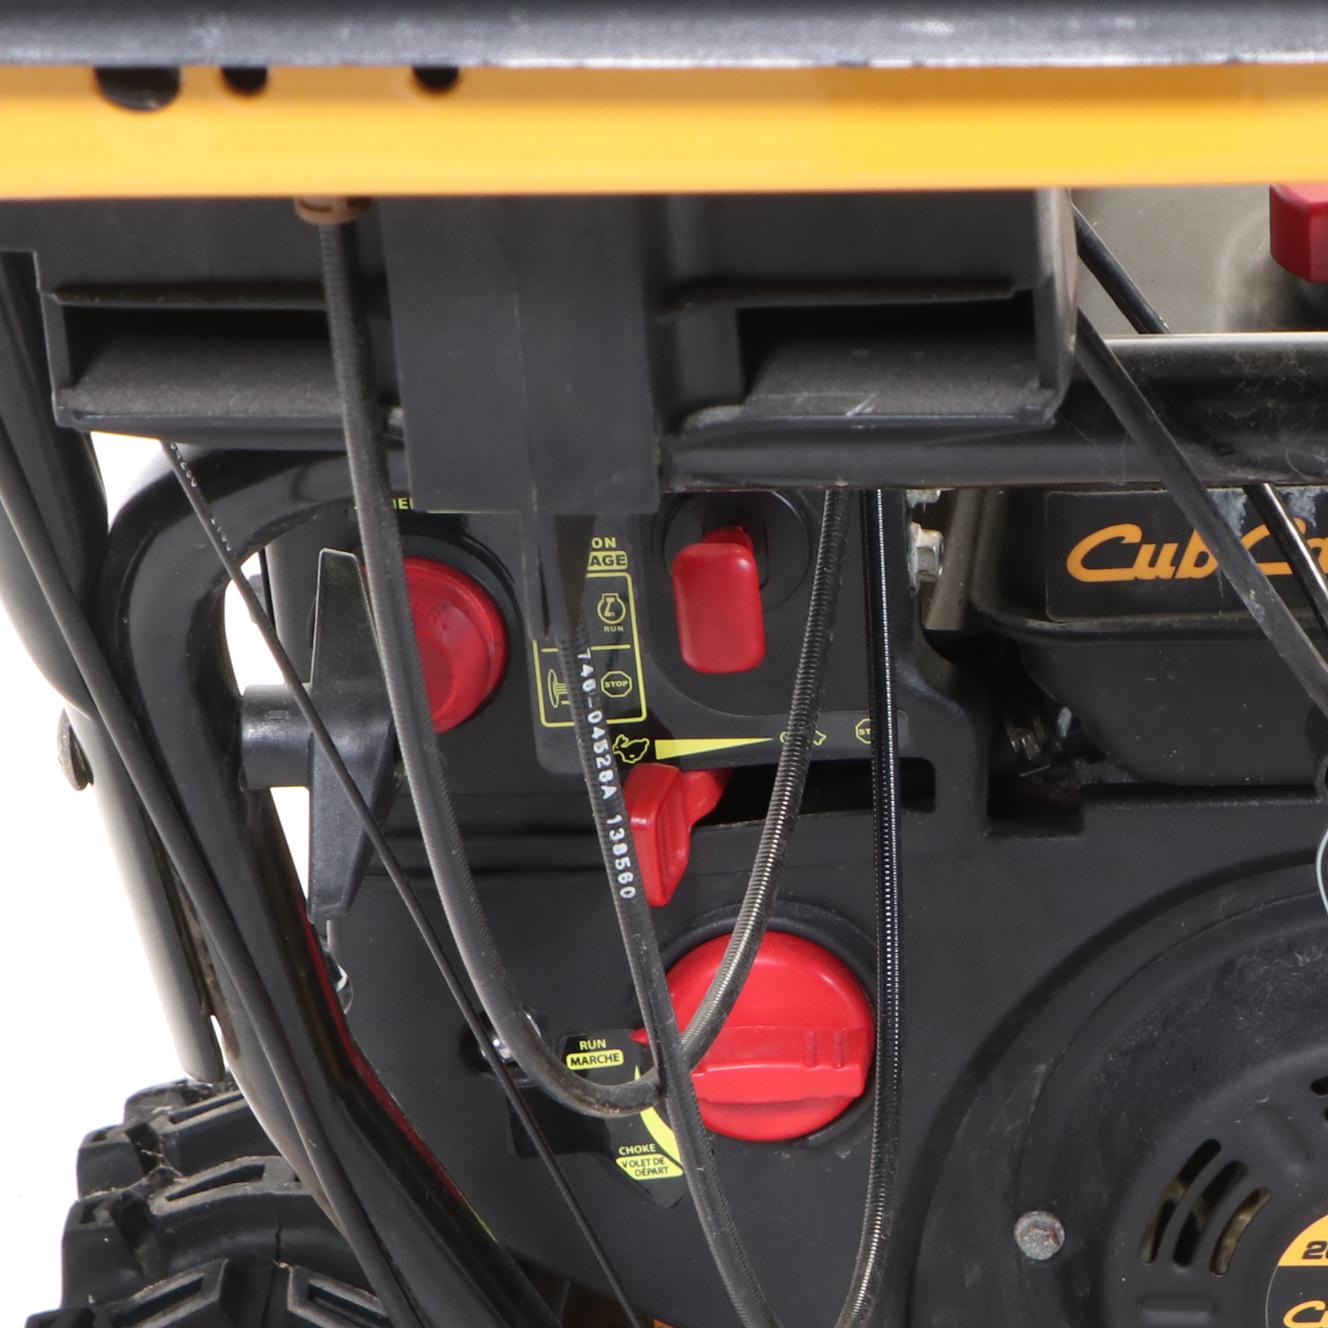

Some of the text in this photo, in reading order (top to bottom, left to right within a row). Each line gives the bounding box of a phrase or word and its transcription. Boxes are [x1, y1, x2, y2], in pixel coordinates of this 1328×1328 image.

[591, 537, 617, 549] ON
[1066, 522, 1219, 583] Cub
[589, 554, 628, 567] AGE
[604, 680, 629, 689] STOP
[579, 1038, 607, 1050] RUN
[570, 1053, 620, 1067] MARCHE
[618, 1143, 656, 1156] CHOKE
[622, 1156, 665, 1169] VOLET DE
